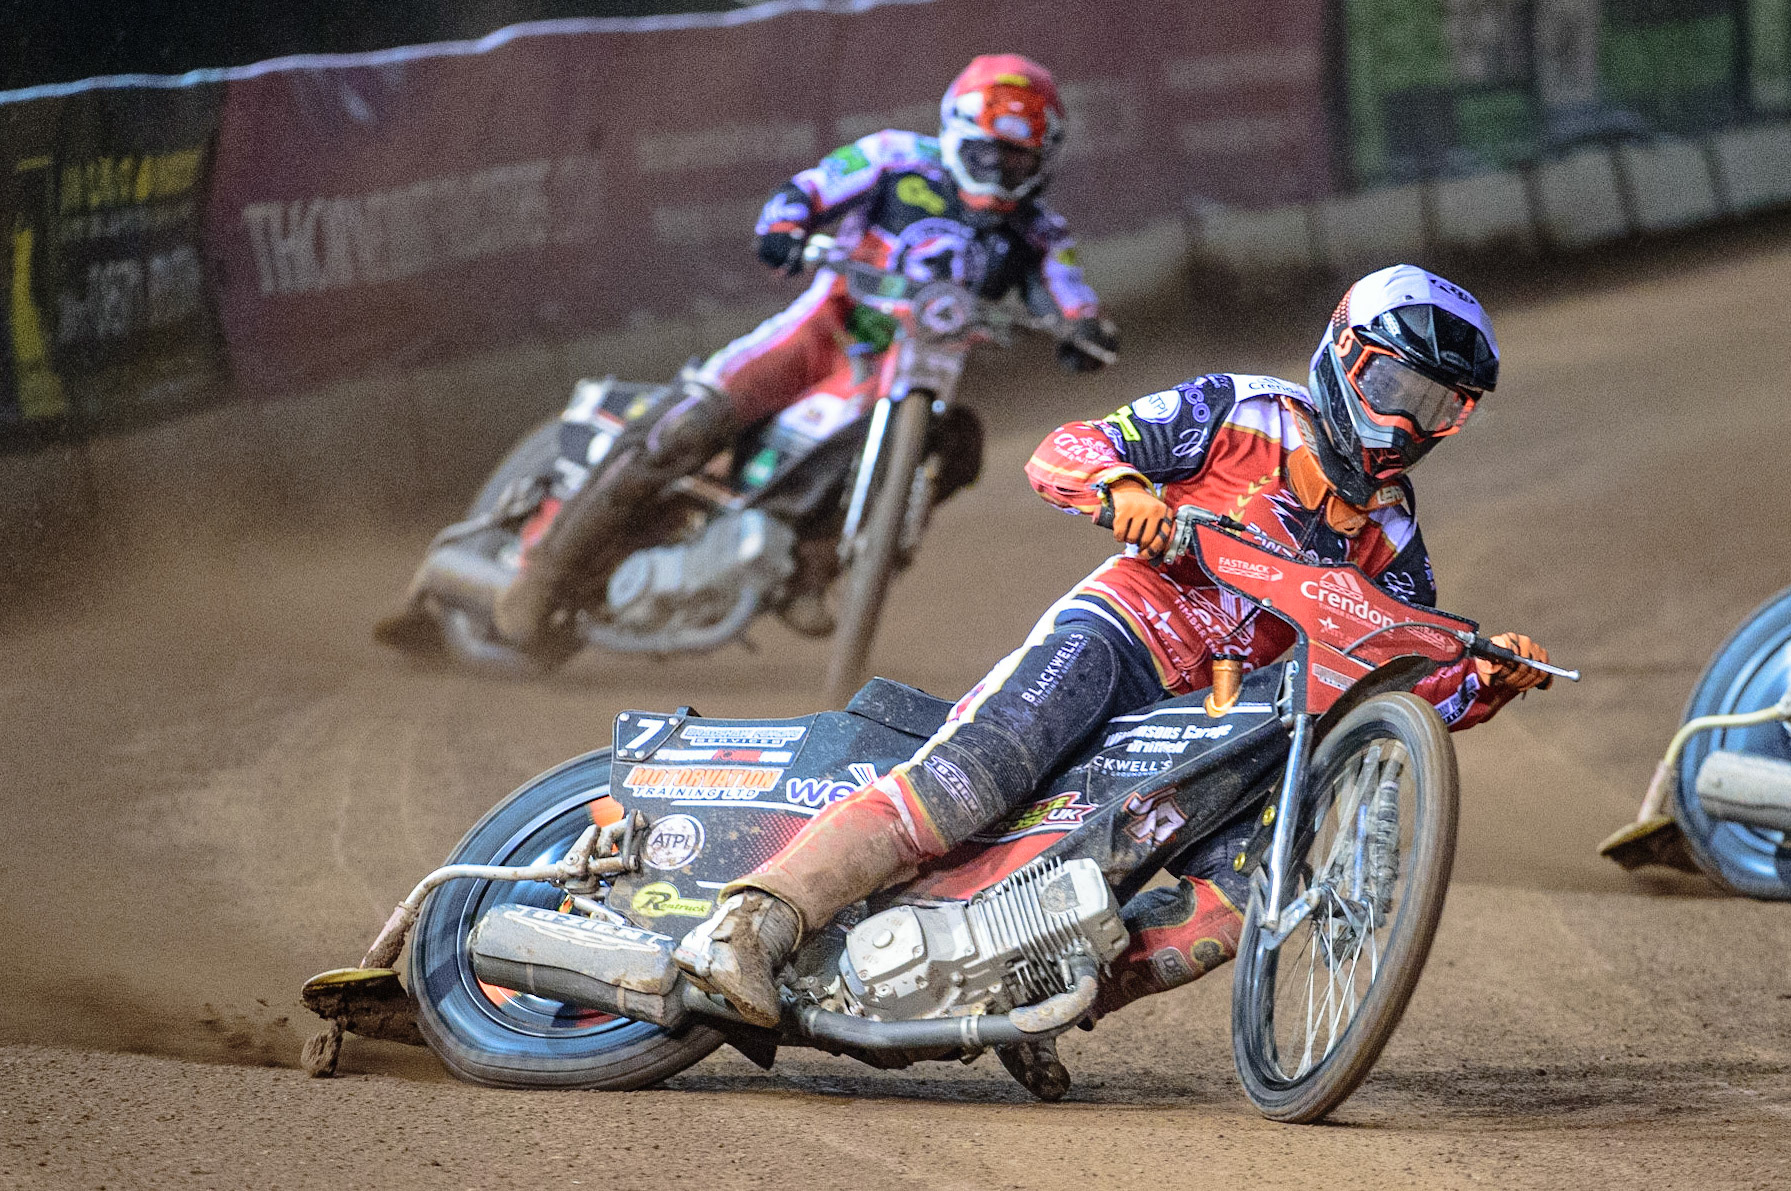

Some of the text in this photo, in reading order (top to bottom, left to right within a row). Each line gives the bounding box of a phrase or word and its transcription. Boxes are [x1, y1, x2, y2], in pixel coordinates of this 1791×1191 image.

[1218, 556, 1271, 574] FASTRACK
[1300, 580, 1395, 633] Crendon
[1021, 633, 1084, 703] BLACKWELL'S
[625, 718, 666, 749] 7
[1181, 724, 1234, 740] Garage
[627, 767, 780, 789] MOTORVATION
[635, 788, 757, 798] TRAINING LTD
[1046, 808, 1082, 820] UK
